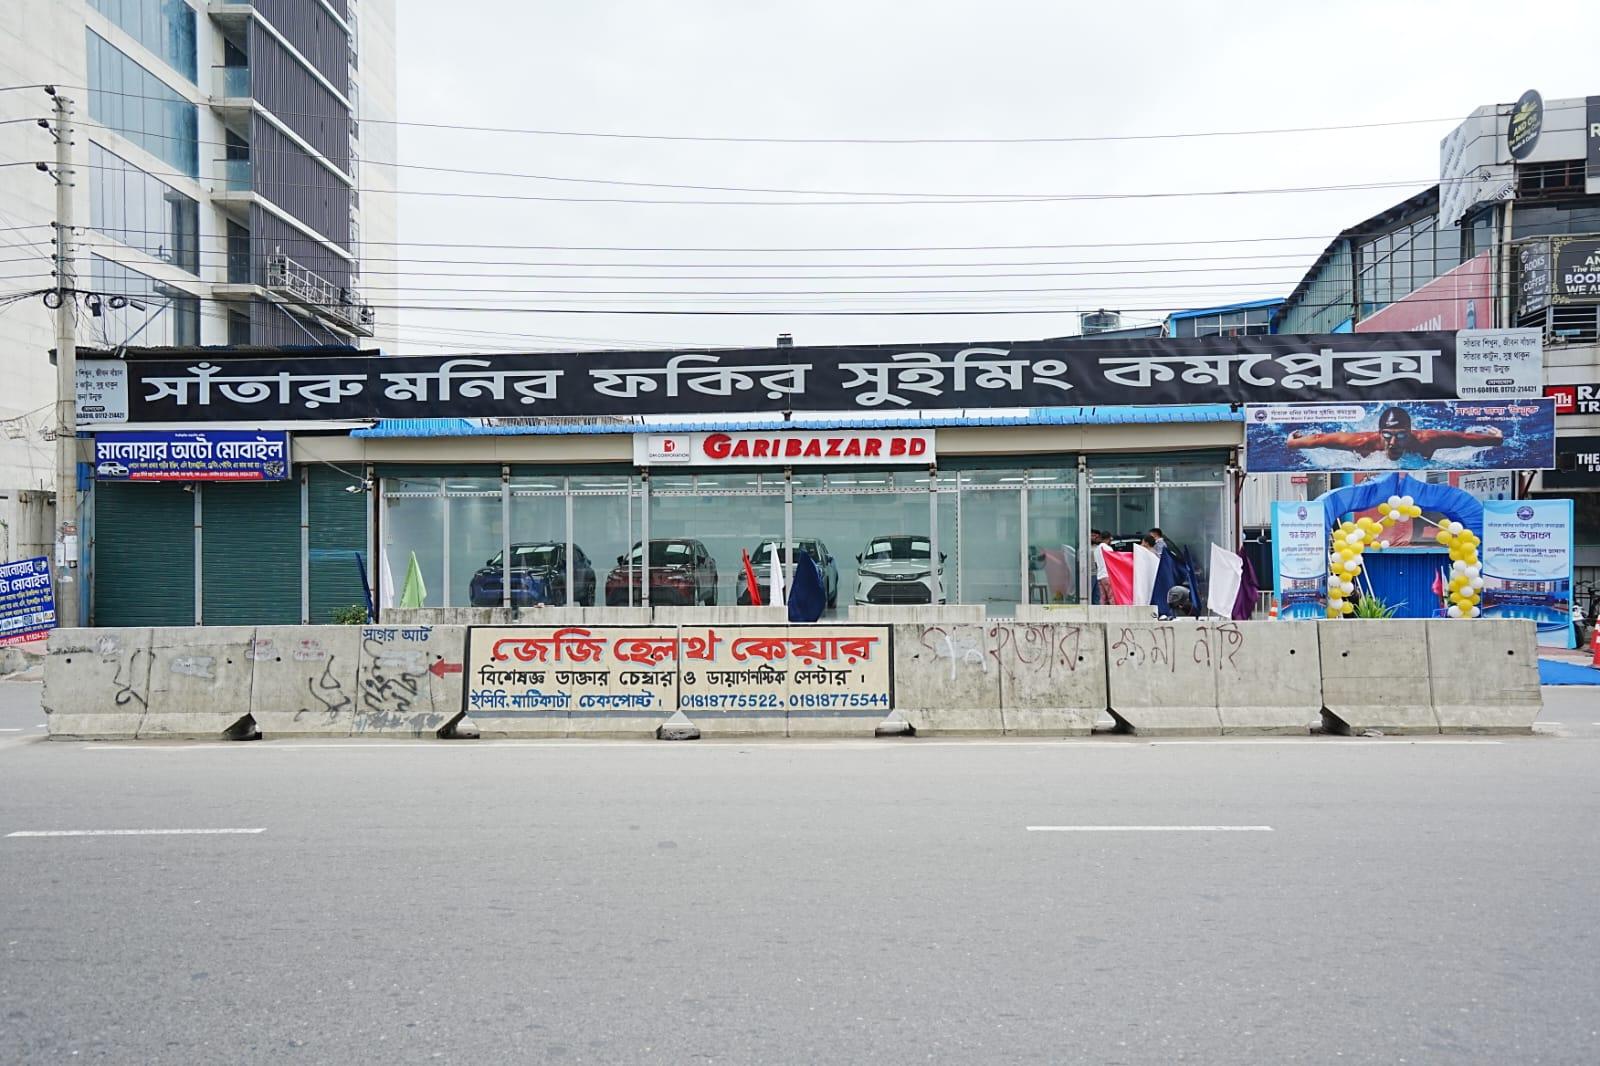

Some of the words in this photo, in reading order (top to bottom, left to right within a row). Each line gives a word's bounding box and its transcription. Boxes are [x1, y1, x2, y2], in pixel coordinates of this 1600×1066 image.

[141, 362, 367, 409] সাঁতারু
[380, 359, 564, 404] মনির
[588, 353, 813, 400] ফকির
[838, 347, 1074, 407] সুইমিং
[1098, 349, 1442, 389] কমপ্লেক্স
[96, 441, 169, 462] মানোয়ার
[171, 436, 213, 460] অটো
[216, 435, 284, 461] মোবাইল
[889, 437, 926, 457] BD
[402, 626, 433, 642] আর্ট
[731, 636, 879, 666] কেয়ার
[478, 664, 546, 686] বিশেষজ্ঞ
[555, 670, 611, 687] ডাক্তার
[619, 670, 677, 687] চেম্বার
[683, 671, 697, 685] ও
[681, 694, 785, 708] 01818775522,
[789, 692, 889, 707] 01818775544
